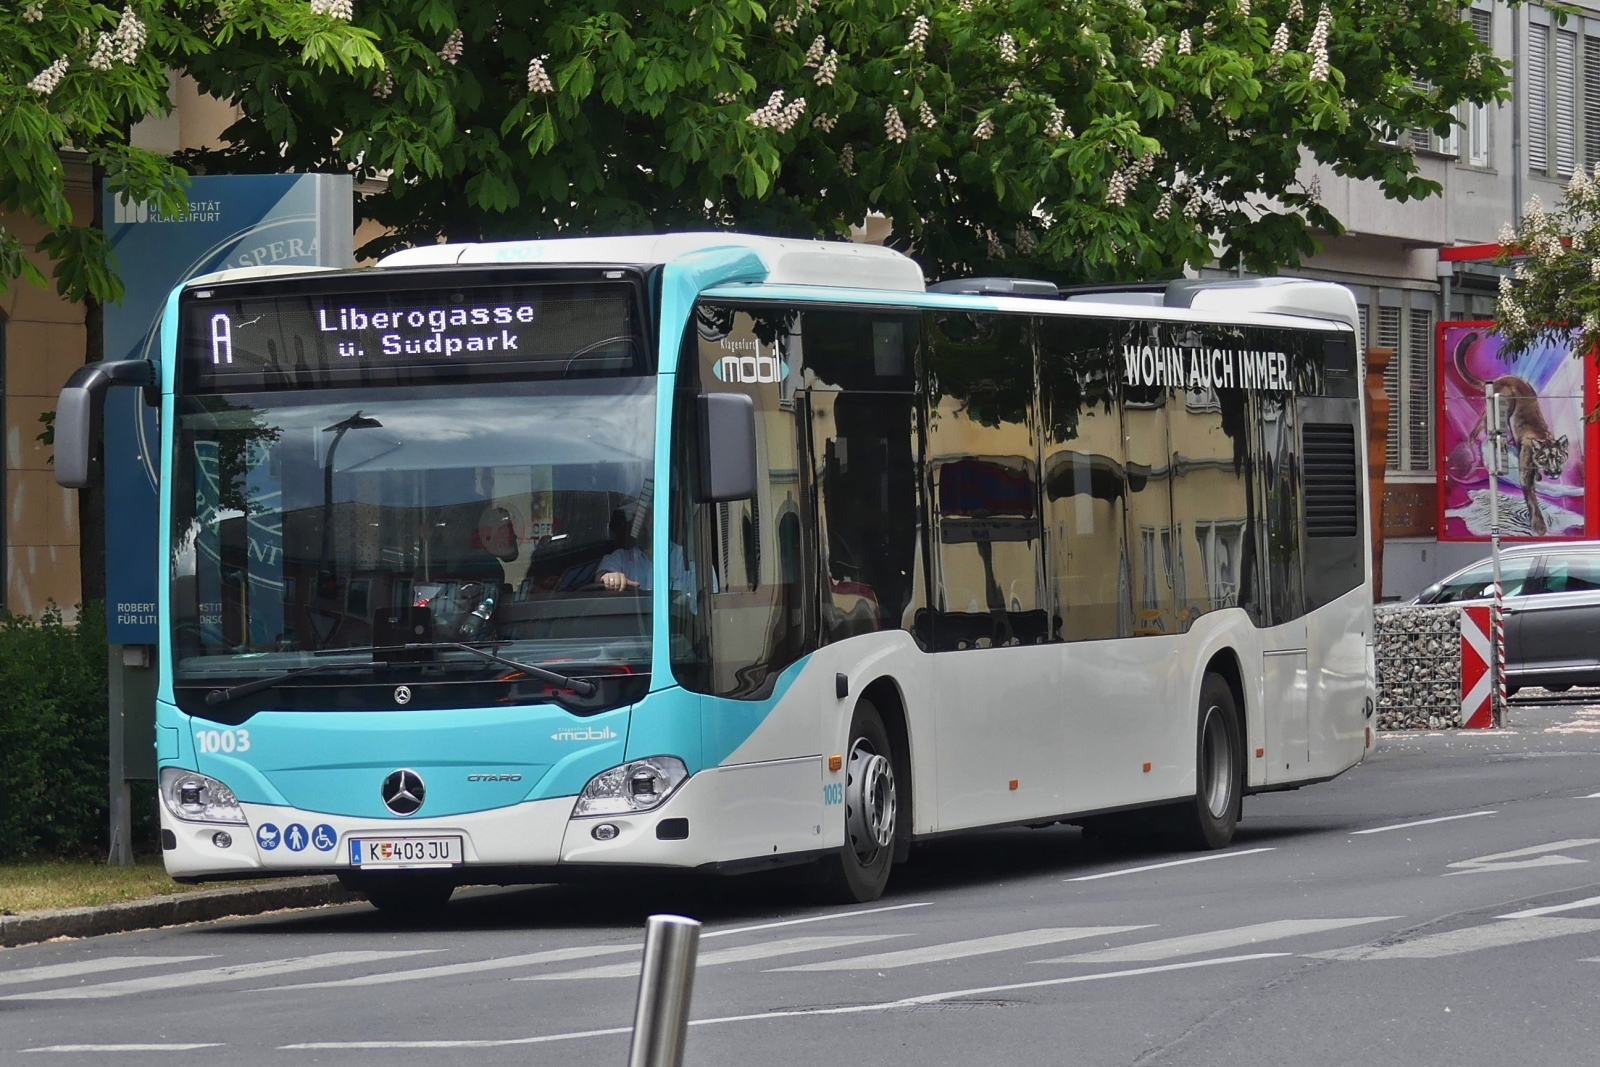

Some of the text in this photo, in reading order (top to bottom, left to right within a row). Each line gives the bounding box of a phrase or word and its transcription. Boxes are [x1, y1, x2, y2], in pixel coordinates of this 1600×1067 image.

[150, 200, 220, 212] UESITÄT
[227, 236, 317, 270] SPERA
[320, 306, 534, 332] Liberogasse
[211, 314, 233, 364] A
[339, 330, 518, 357] ü. Südpark
[720, 338, 756, 353] Klagenfurt
[721, 339, 781, 384] mobil
[1124, 345, 1292, 391] WOHIN AUCH IMMER.
[118, 613, 137, 625] FÜR
[196, 729, 250, 753] 1003
[558, 726, 610, 741] mobil
[467, 773, 522, 782] CITARO
[823, 783, 843, 806] 1003
[370, 841, 449, 860] K 403 JU
